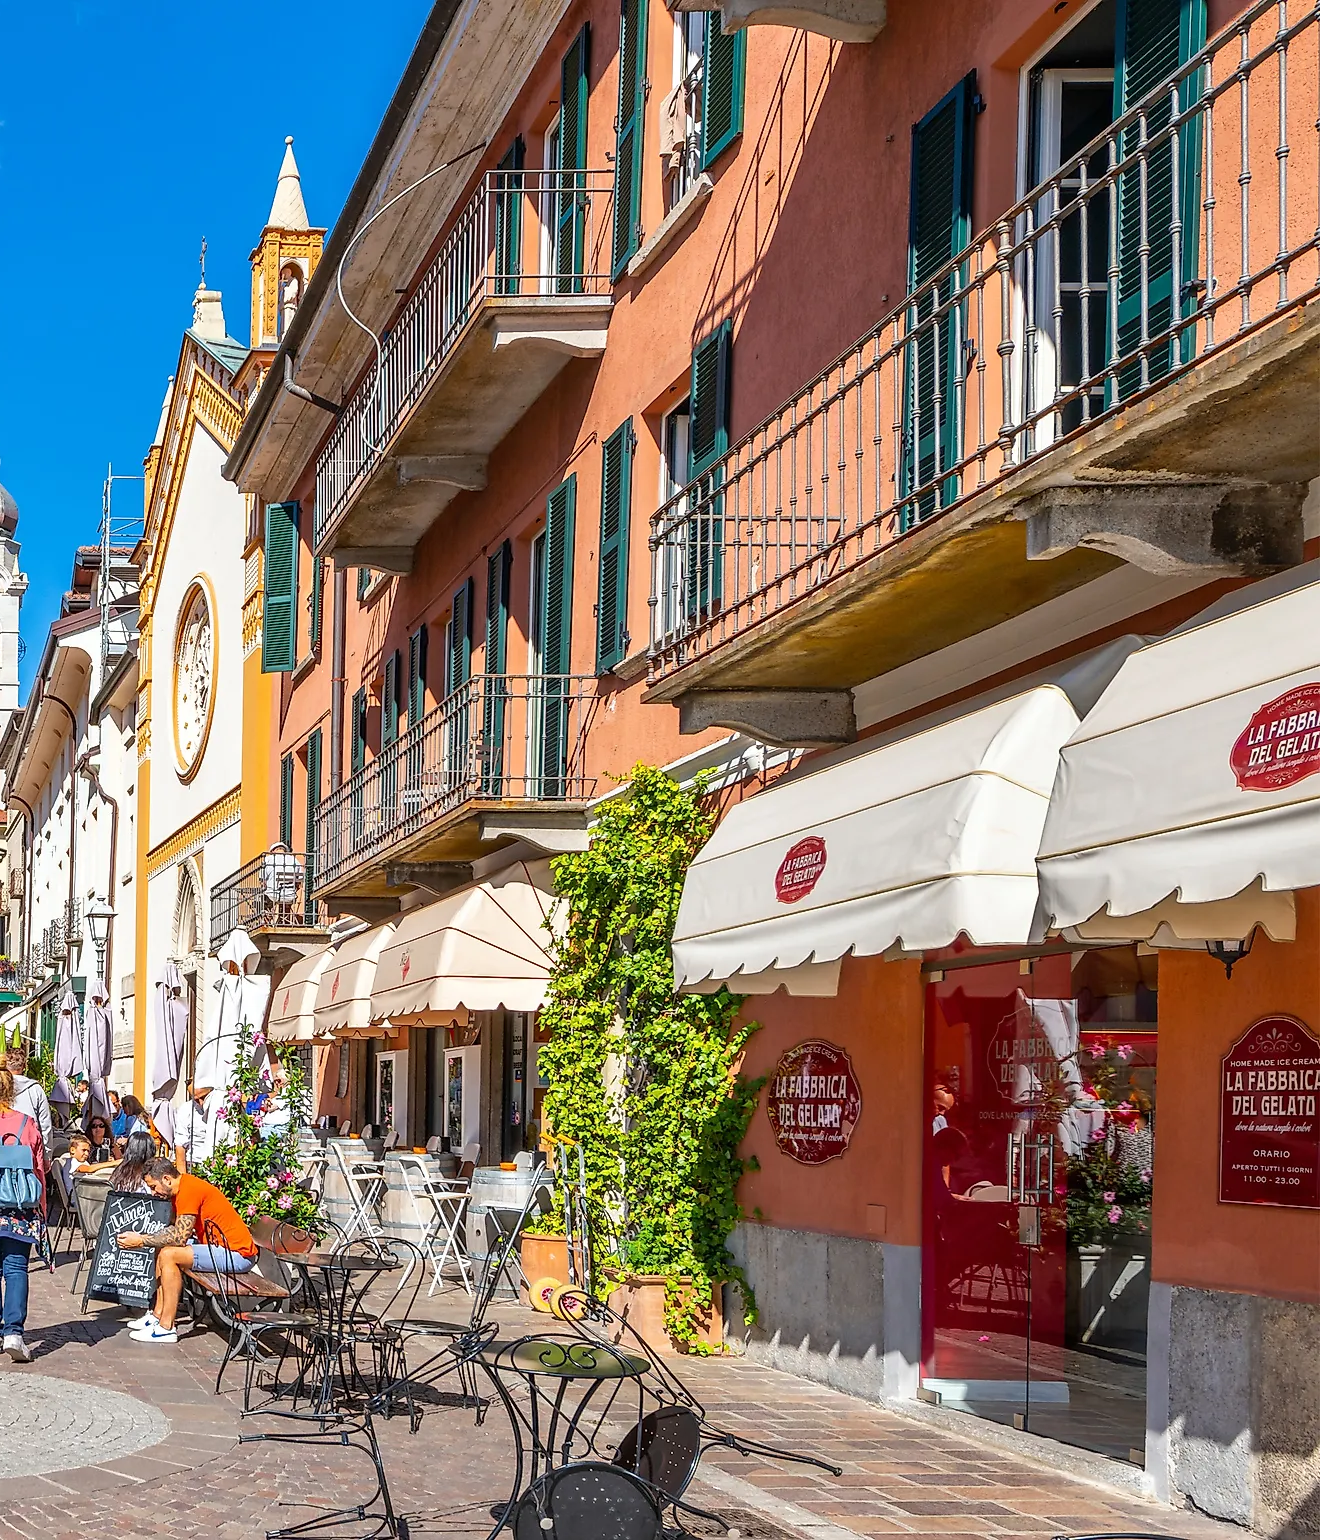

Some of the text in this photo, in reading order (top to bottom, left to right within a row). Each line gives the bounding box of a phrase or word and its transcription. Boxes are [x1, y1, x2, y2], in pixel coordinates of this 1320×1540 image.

[1267, 701, 1285, 715] HOME
[1285, 690, 1303, 703] MADE
[1303, 688, 1314, 697] ICE
[1247, 724, 1266, 746] LA
[1248, 743, 1272, 767] DEL
[783, 850, 822, 873] LA FABBRICA
[781, 867, 816, 886] DEL GELATO
[821, 1047, 838, 1064] CREAM
[995, 1041, 1009, 1059] LA
[1292, 1058, 1320, 1066] CREAM
[775, 1075, 847, 1099] LA FABBRICA
[1226, 1069, 1320, 1092] LA FABBRICA
[779, 1103, 841, 1128] DEL GELATO
[1232, 1096, 1316, 1116] DEL GELATO
[1235, 1121, 1248, 1131] dove
[1253, 1150, 1290, 1158] ORARIO
[1244, 1175, 1267, 1183] 11.00
[1275, 1176, 1300, 1185] 23.00
